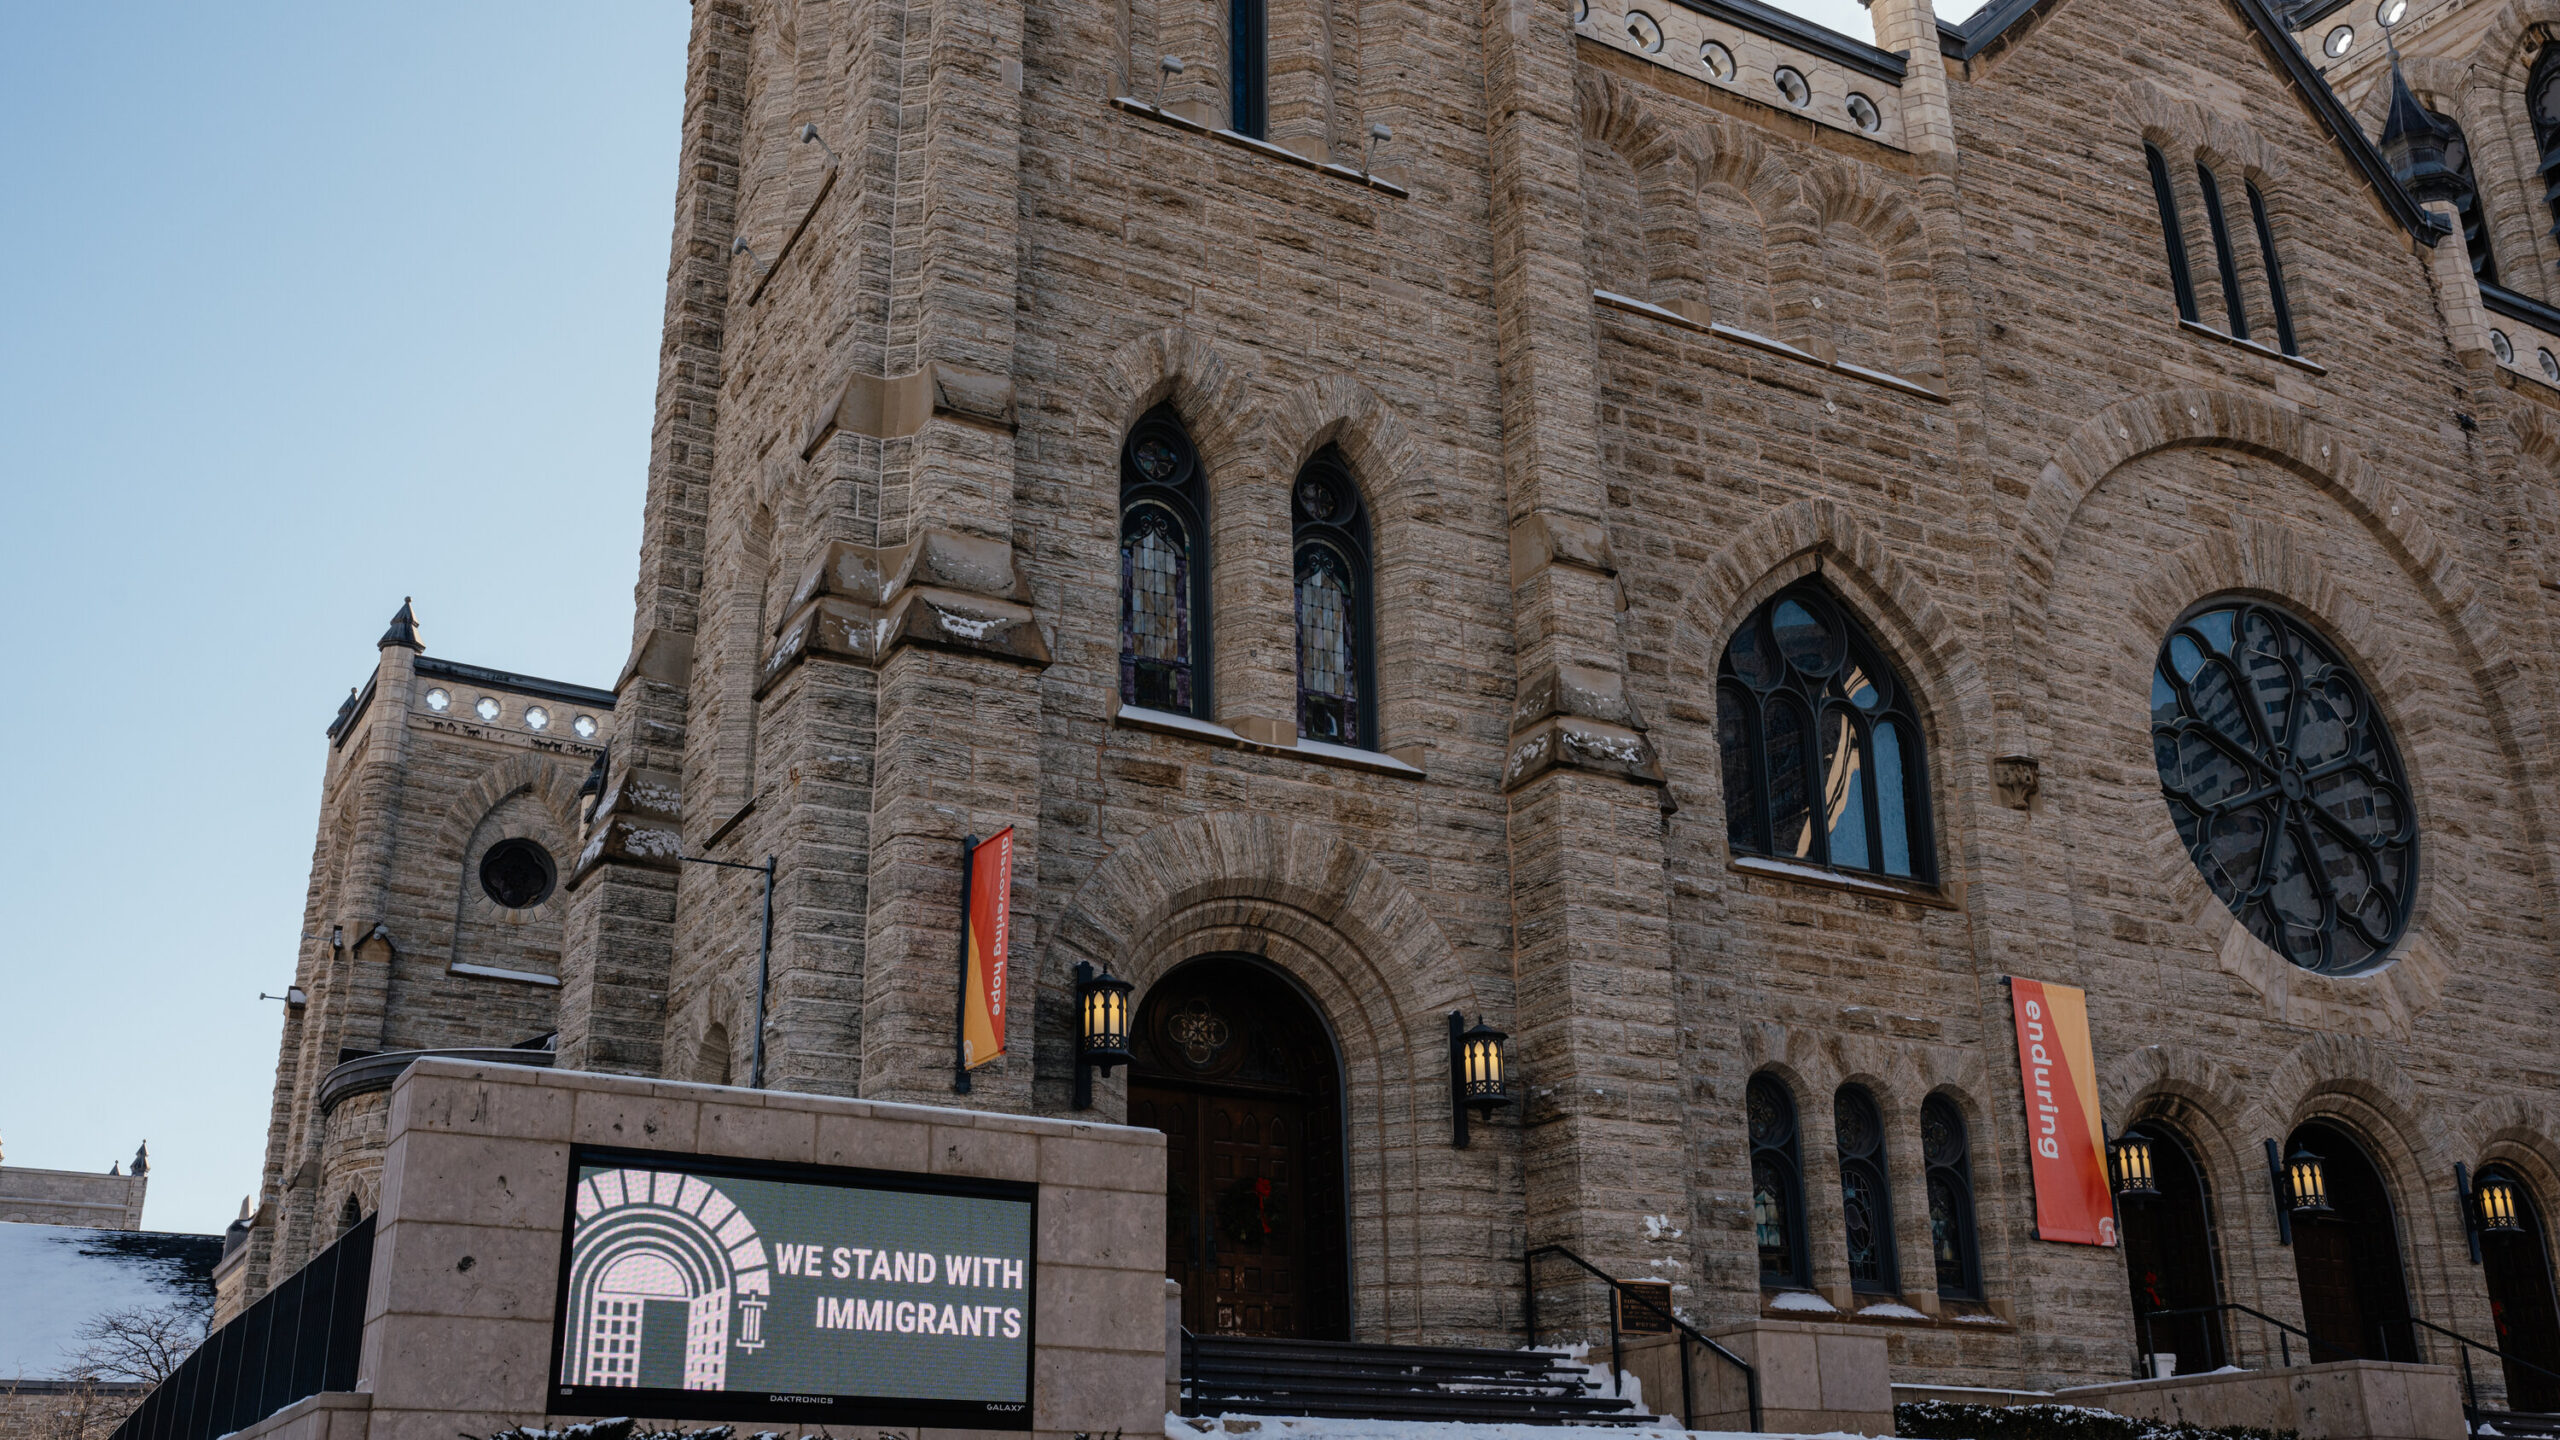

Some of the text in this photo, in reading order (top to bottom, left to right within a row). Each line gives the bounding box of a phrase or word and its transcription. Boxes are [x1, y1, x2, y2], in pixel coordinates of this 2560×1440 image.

[992, 836, 1009, 1016] discovering hope
[2025, 1000, 2059, 1159] enduring
[775, 1242, 1023, 1289] WE STAND WITH
[815, 1297, 1021, 1339] IMMIGRANTS
[770, 1395, 834, 1404] DAKTRONICS
[986, 1403, 1023, 1411] GALAXY
